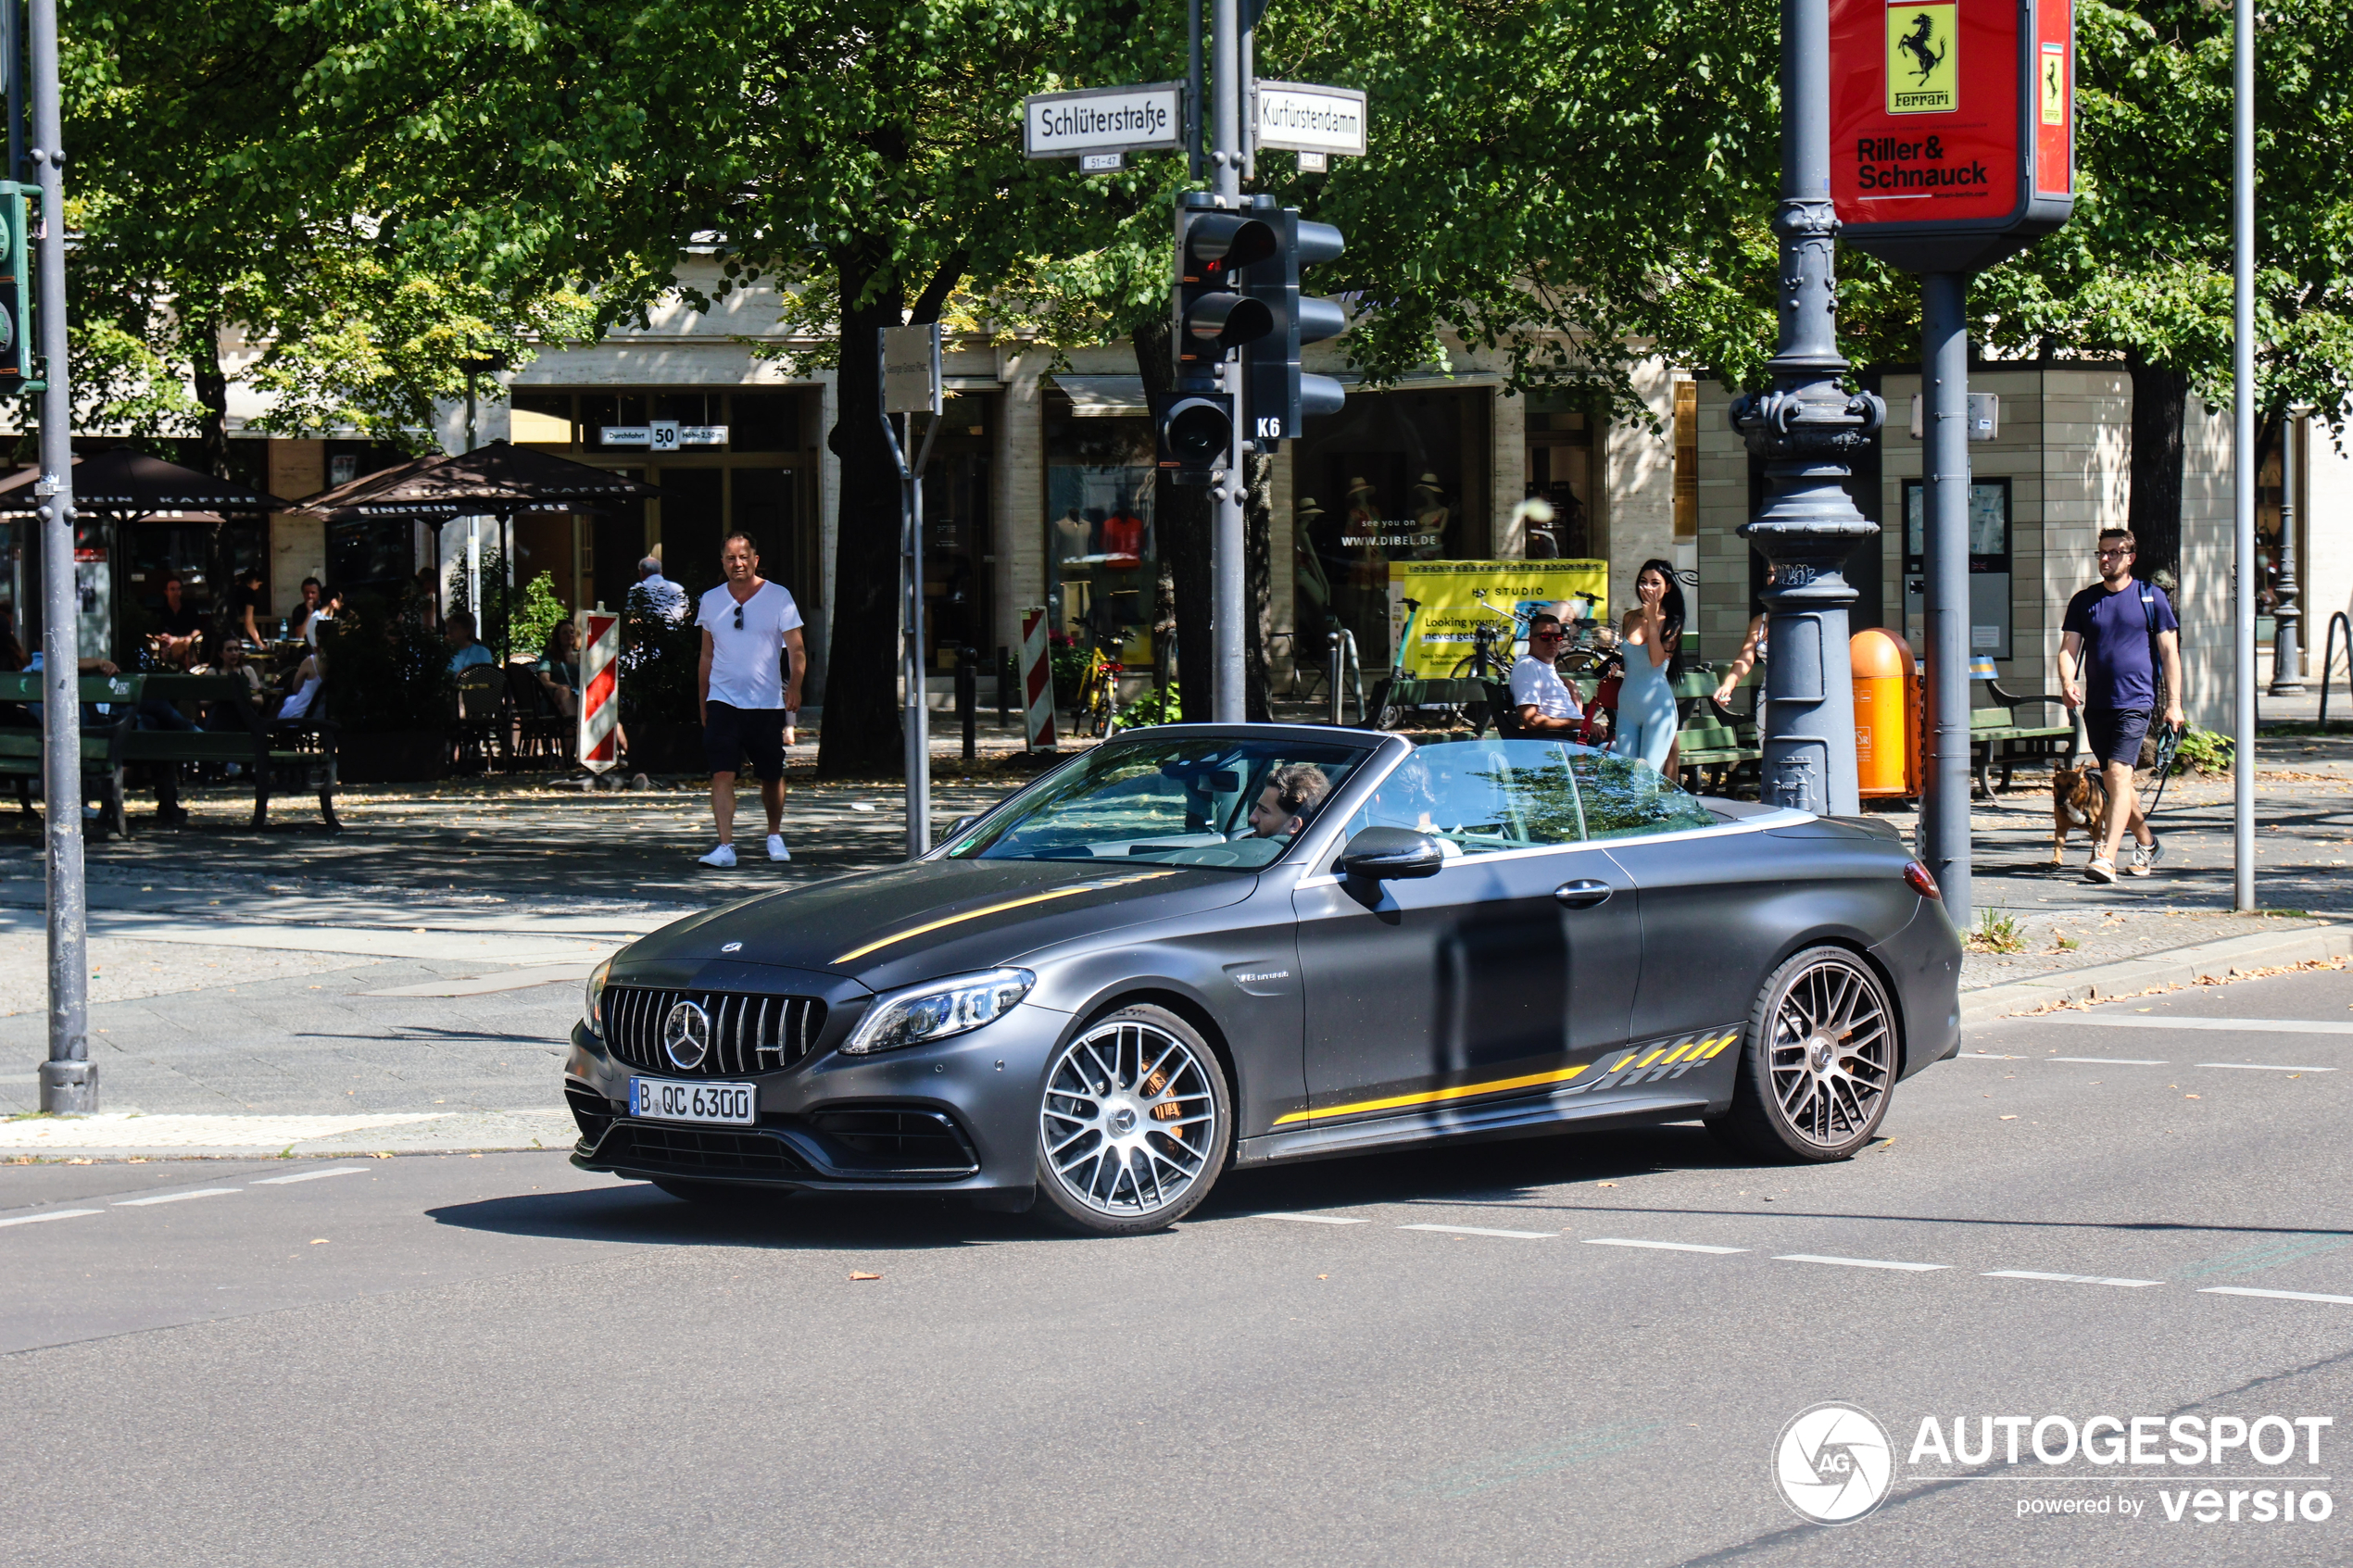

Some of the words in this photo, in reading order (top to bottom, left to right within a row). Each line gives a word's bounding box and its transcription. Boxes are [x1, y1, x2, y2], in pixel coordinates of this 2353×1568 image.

[1894, 90, 1949, 107] Ferrari
[1042, 100, 1166, 137] Schlüterstraße
[1263, 97, 1357, 134] Kurfürstendamm
[1857, 137, 1922, 162] Riller
[1925, 135, 1944, 159] &
[1858, 160, 1988, 190] Schnauck
[1257, 417, 1280, 438] K6
[655, 429, 673, 443] 50
[701, 432, 716, 440] 2,50
[358, 506, 458, 515] EINSTEIN
[1382, 520, 1400, 528] you
[1341, 536, 1436, 546] WWW.DIBEL.DE
[1495, 587, 1544, 596] STUDIO
[1425, 618, 1466, 628] Looking
[640, 1084, 651, 1111] B
[662, 1085, 687, 1115] QC
[693, 1088, 749, 1118] 6300
